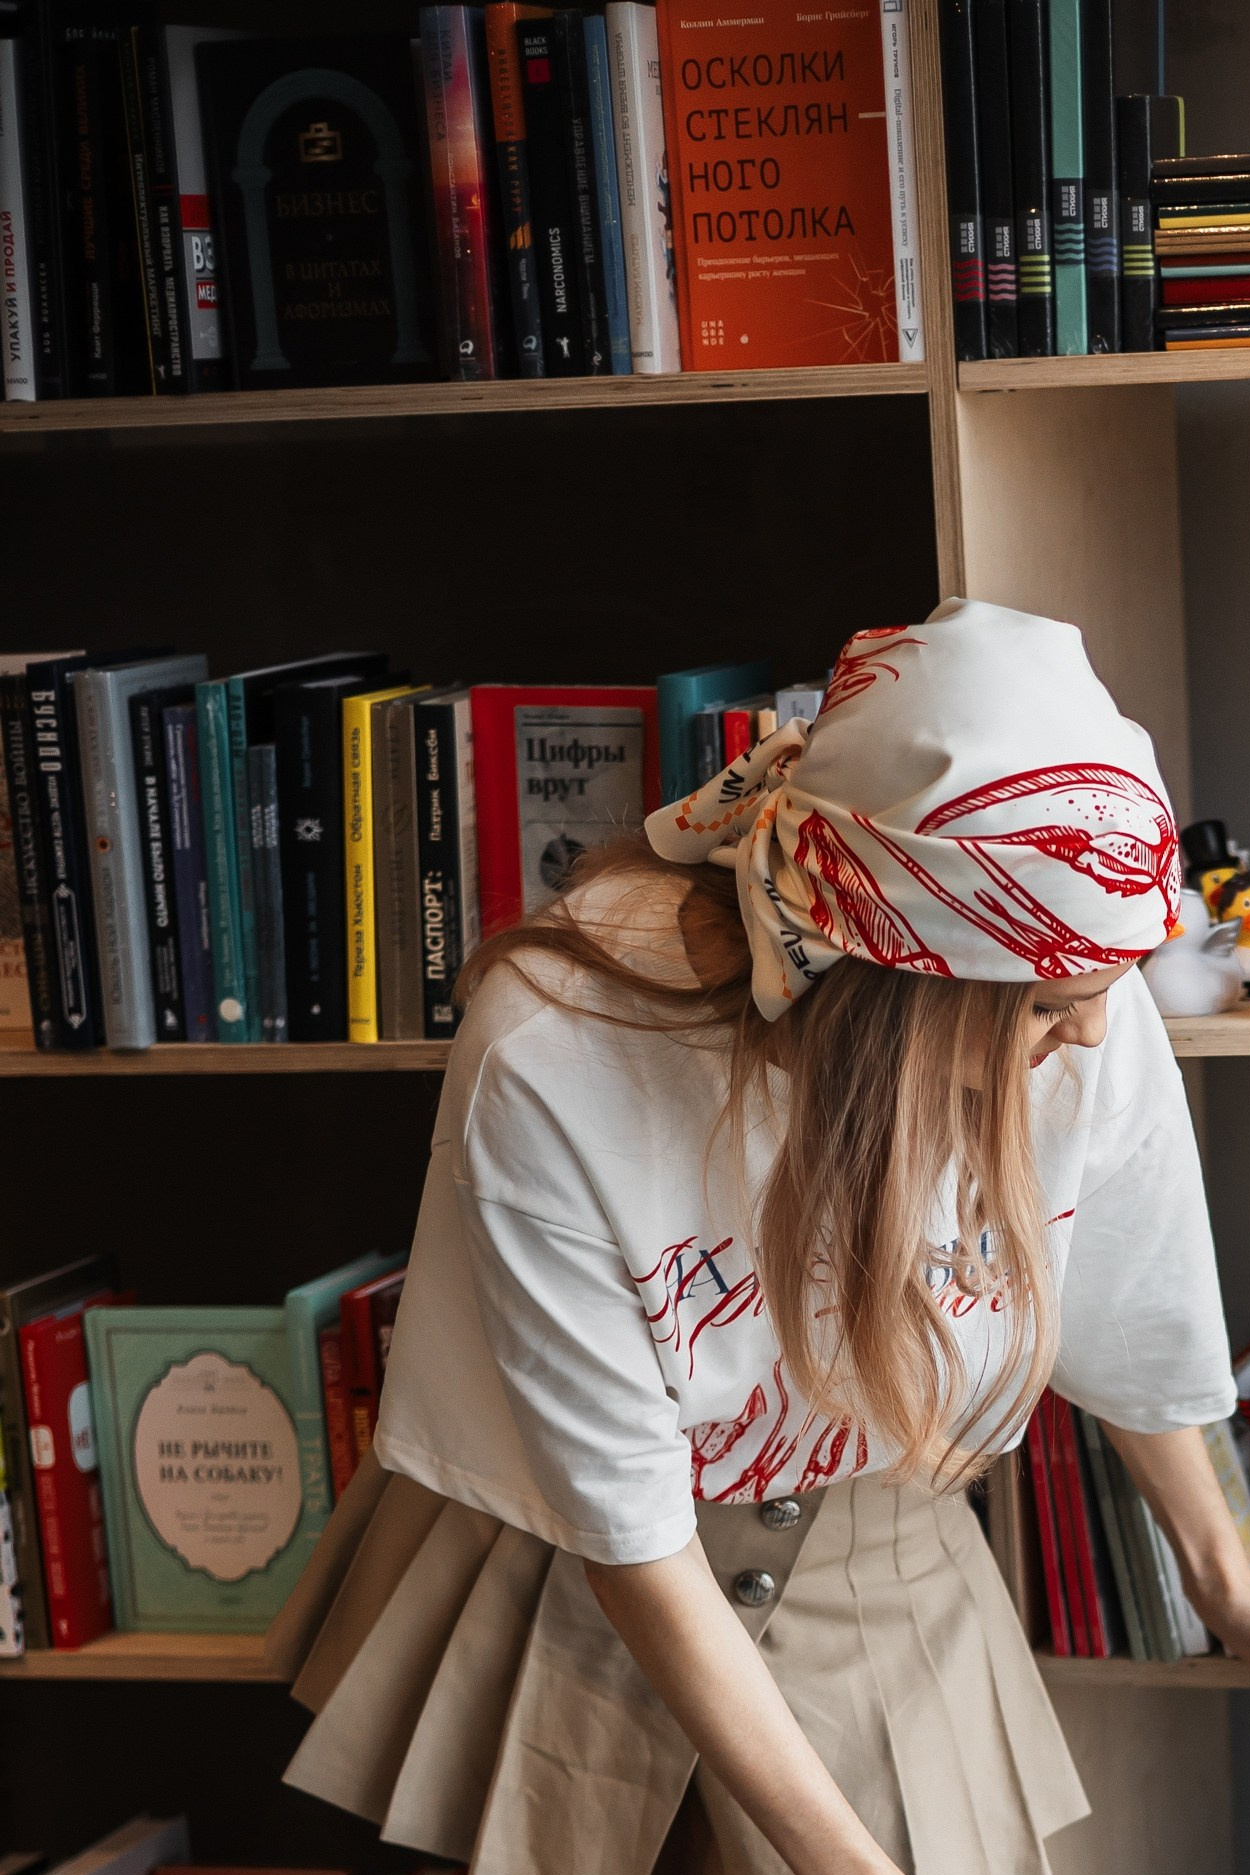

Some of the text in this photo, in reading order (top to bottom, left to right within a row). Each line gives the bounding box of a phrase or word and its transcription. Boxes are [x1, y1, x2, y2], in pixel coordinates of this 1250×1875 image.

[440, 29, 454, 81] КИТАЙ
[524, 36, 547, 46] BLACK
[525, 46, 548, 56] BOOKS
[681, 50, 846, 91] ОСКОЛКИ
[430, 70, 446, 142] БИЗНЕСА
[615, 32, 636, 206] МЕНЕДЖМЕНТ ВО ВРЕМЯ ШТОРМА
[73, 64, 96, 262] ЛУЧШИЕ СРЕДИ ВЕЛИКИХ
[688, 157, 781, 193] НОГО
[274, 190, 379, 218] БИЗНЕС
[572, 118, 595, 264] УПРАВЛЕНИЕ ВНИМАНИЕМ
[899, 190, 907, 211] путь
[692, 205, 855, 244] ПОТОЛКА
[900, 219, 909, 248] успеху
[0, 211, 21, 362] УПАКУЙ И ПРОДАЙ
[284, 259, 382, 280] В ЦИТАТАХ
[328, 281, 341, 298] И
[548, 227, 567, 313] NARCONOMICS
[146, 267, 162, 338] МАРКЕТИНГ
[158, 205, 182, 377] КАК ВЗОРВАТЬ МЕДИАПРОСТРАНСТВО
[283, 300, 391, 320] АФОРИЗМАХ
[31, 689, 63, 773] БУСИДО
[526, 738, 626, 769] Цифры
[145, 775, 157, 786] В
[350, 727, 363, 843] Обратная связь
[425, 728, 443, 841] Патрик Биксби
[527, 775, 588, 801] врут
[719, 769, 745, 804] UN
[8, 720, 40, 895] ИСКУССТВО ВОЙНЫ
[146, 787, 163, 839] НАЧАЛЕ
[150, 841, 165, 881] БЫЛО
[153, 883, 169, 928] НИЧТО
[424, 870, 446, 980] ПАСПОРТ:
[159, 1439, 272, 1459] НЕ РЫЧИТЕ
[159, 1464, 284, 1484] НА СОБАКУ!
